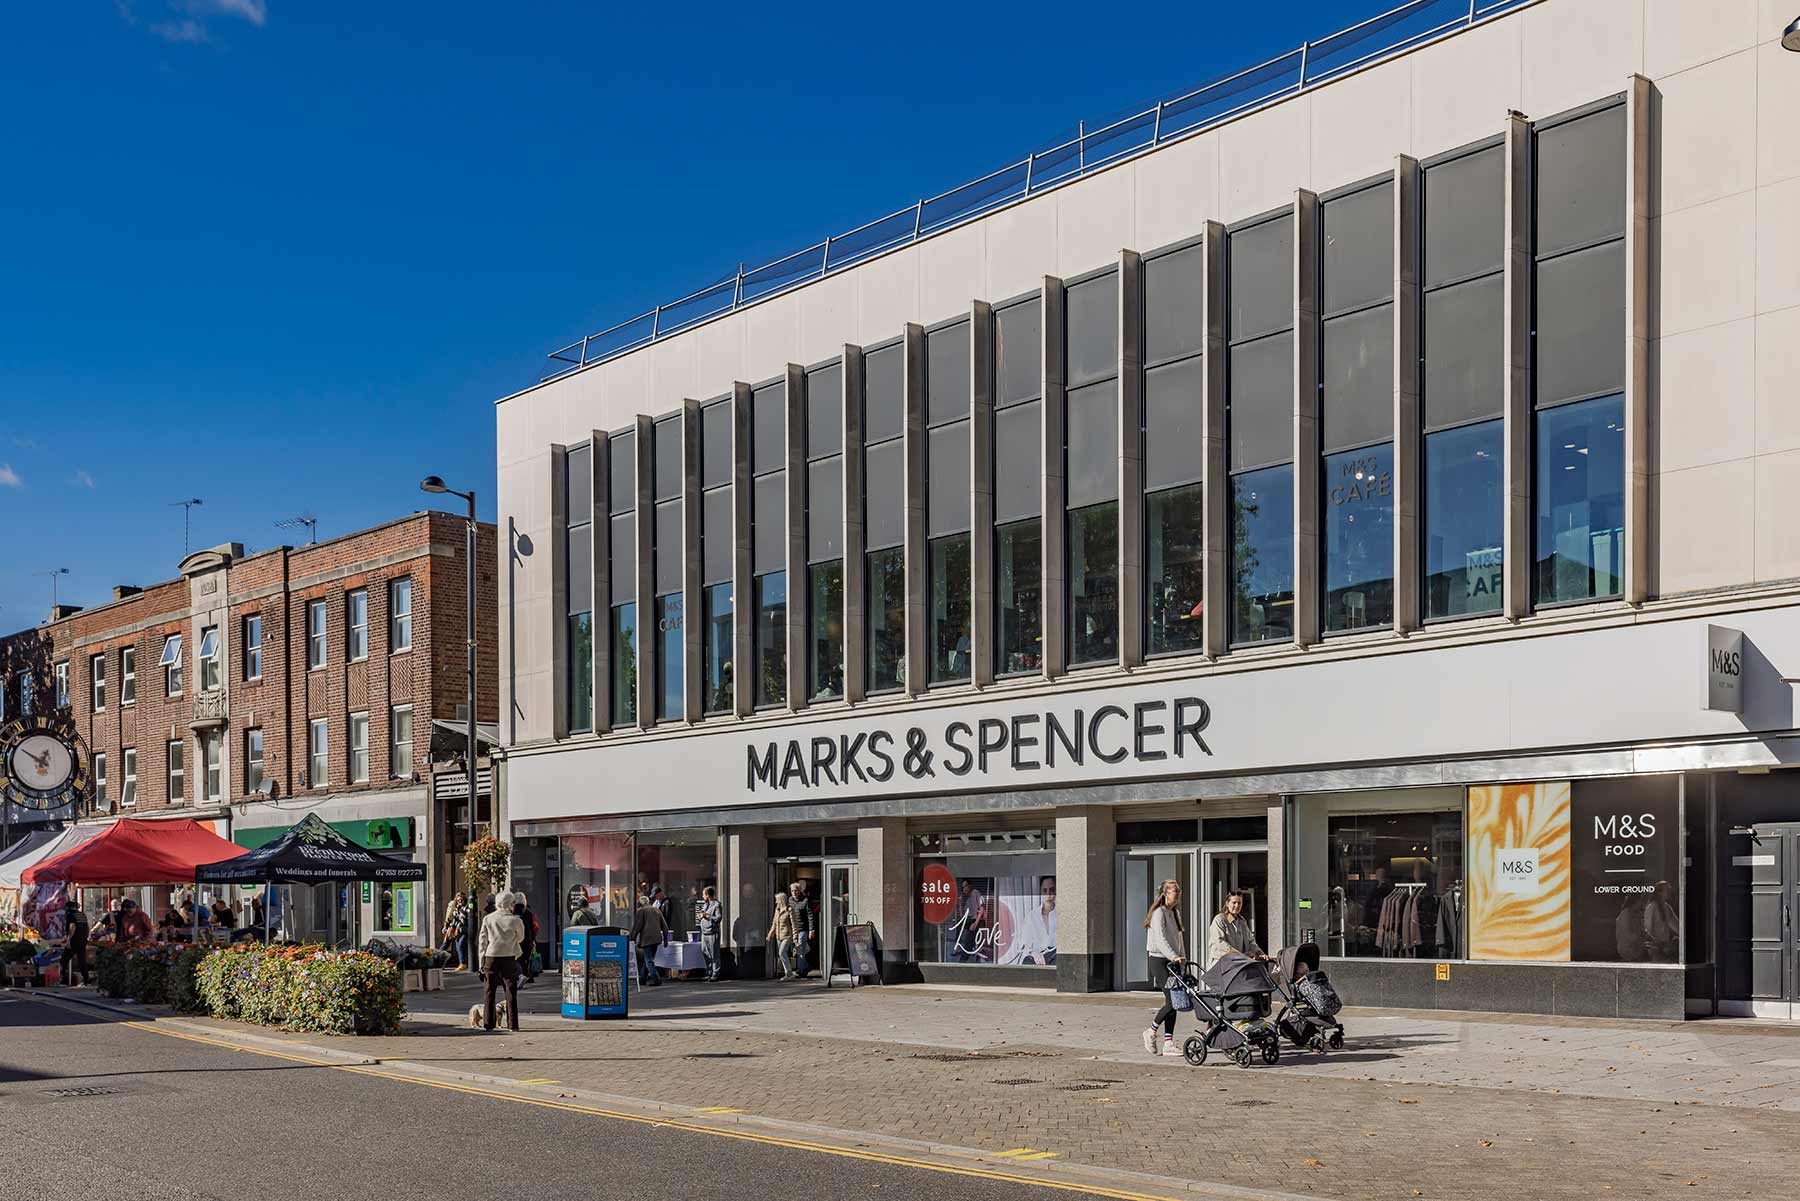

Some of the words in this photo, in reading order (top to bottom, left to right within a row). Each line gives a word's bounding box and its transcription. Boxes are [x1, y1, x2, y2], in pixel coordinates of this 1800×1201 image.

[1330, 472, 1392, 506] CAFÉ
[1467, 573, 1502, 597] AF
[1712, 648, 1740, 676] M&S
[746, 730, 895, 792] MARKS
[903, 726, 936, 779] &
[943, 696, 1213, 776] SPENCER
[1594, 813, 1656, 839] M&S
[1605, 845, 1645, 856] FOOD
[275, 867, 313, 876] Weddings
[313, 868, 327, 876] and
[328, 868, 357, 876] funerals
[1502, 860, 1533, 874] M&S
[921, 880, 951, 893] sale
[1621, 885, 1656, 893] GROUND
[936, 896, 951, 904] OFF
[948, 907, 1006, 955] Love
